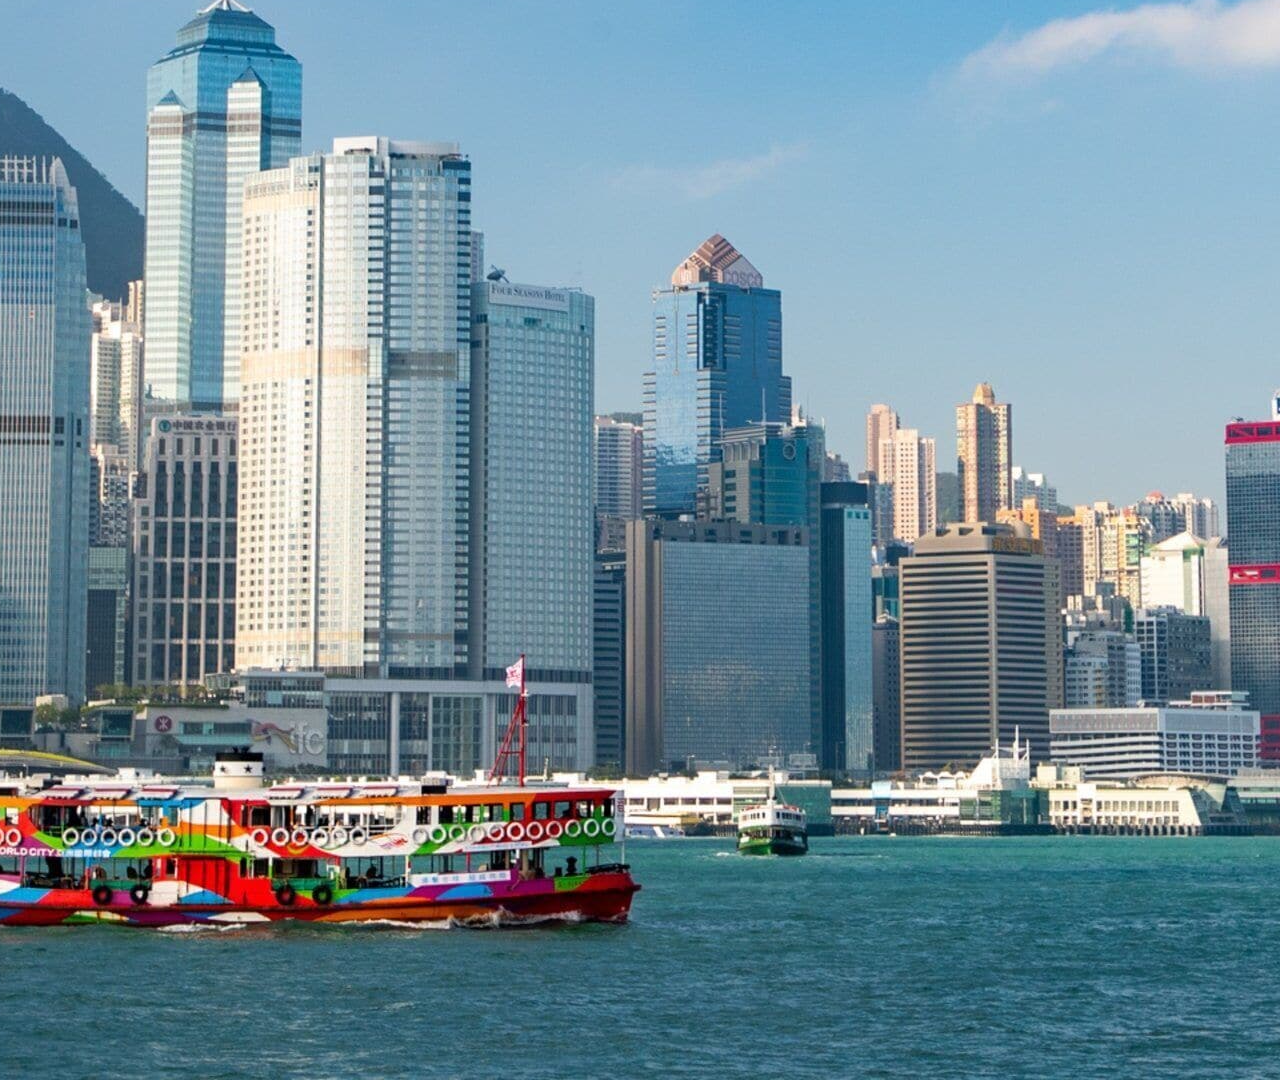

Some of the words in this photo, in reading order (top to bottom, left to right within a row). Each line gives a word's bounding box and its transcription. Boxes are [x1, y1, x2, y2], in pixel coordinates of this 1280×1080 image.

[491, 283, 512, 296] FOUR
[513, 287, 544, 299] SEASONS
[544, 290, 566, 303] HOTEL
[29, 847, 55, 857] CITY
